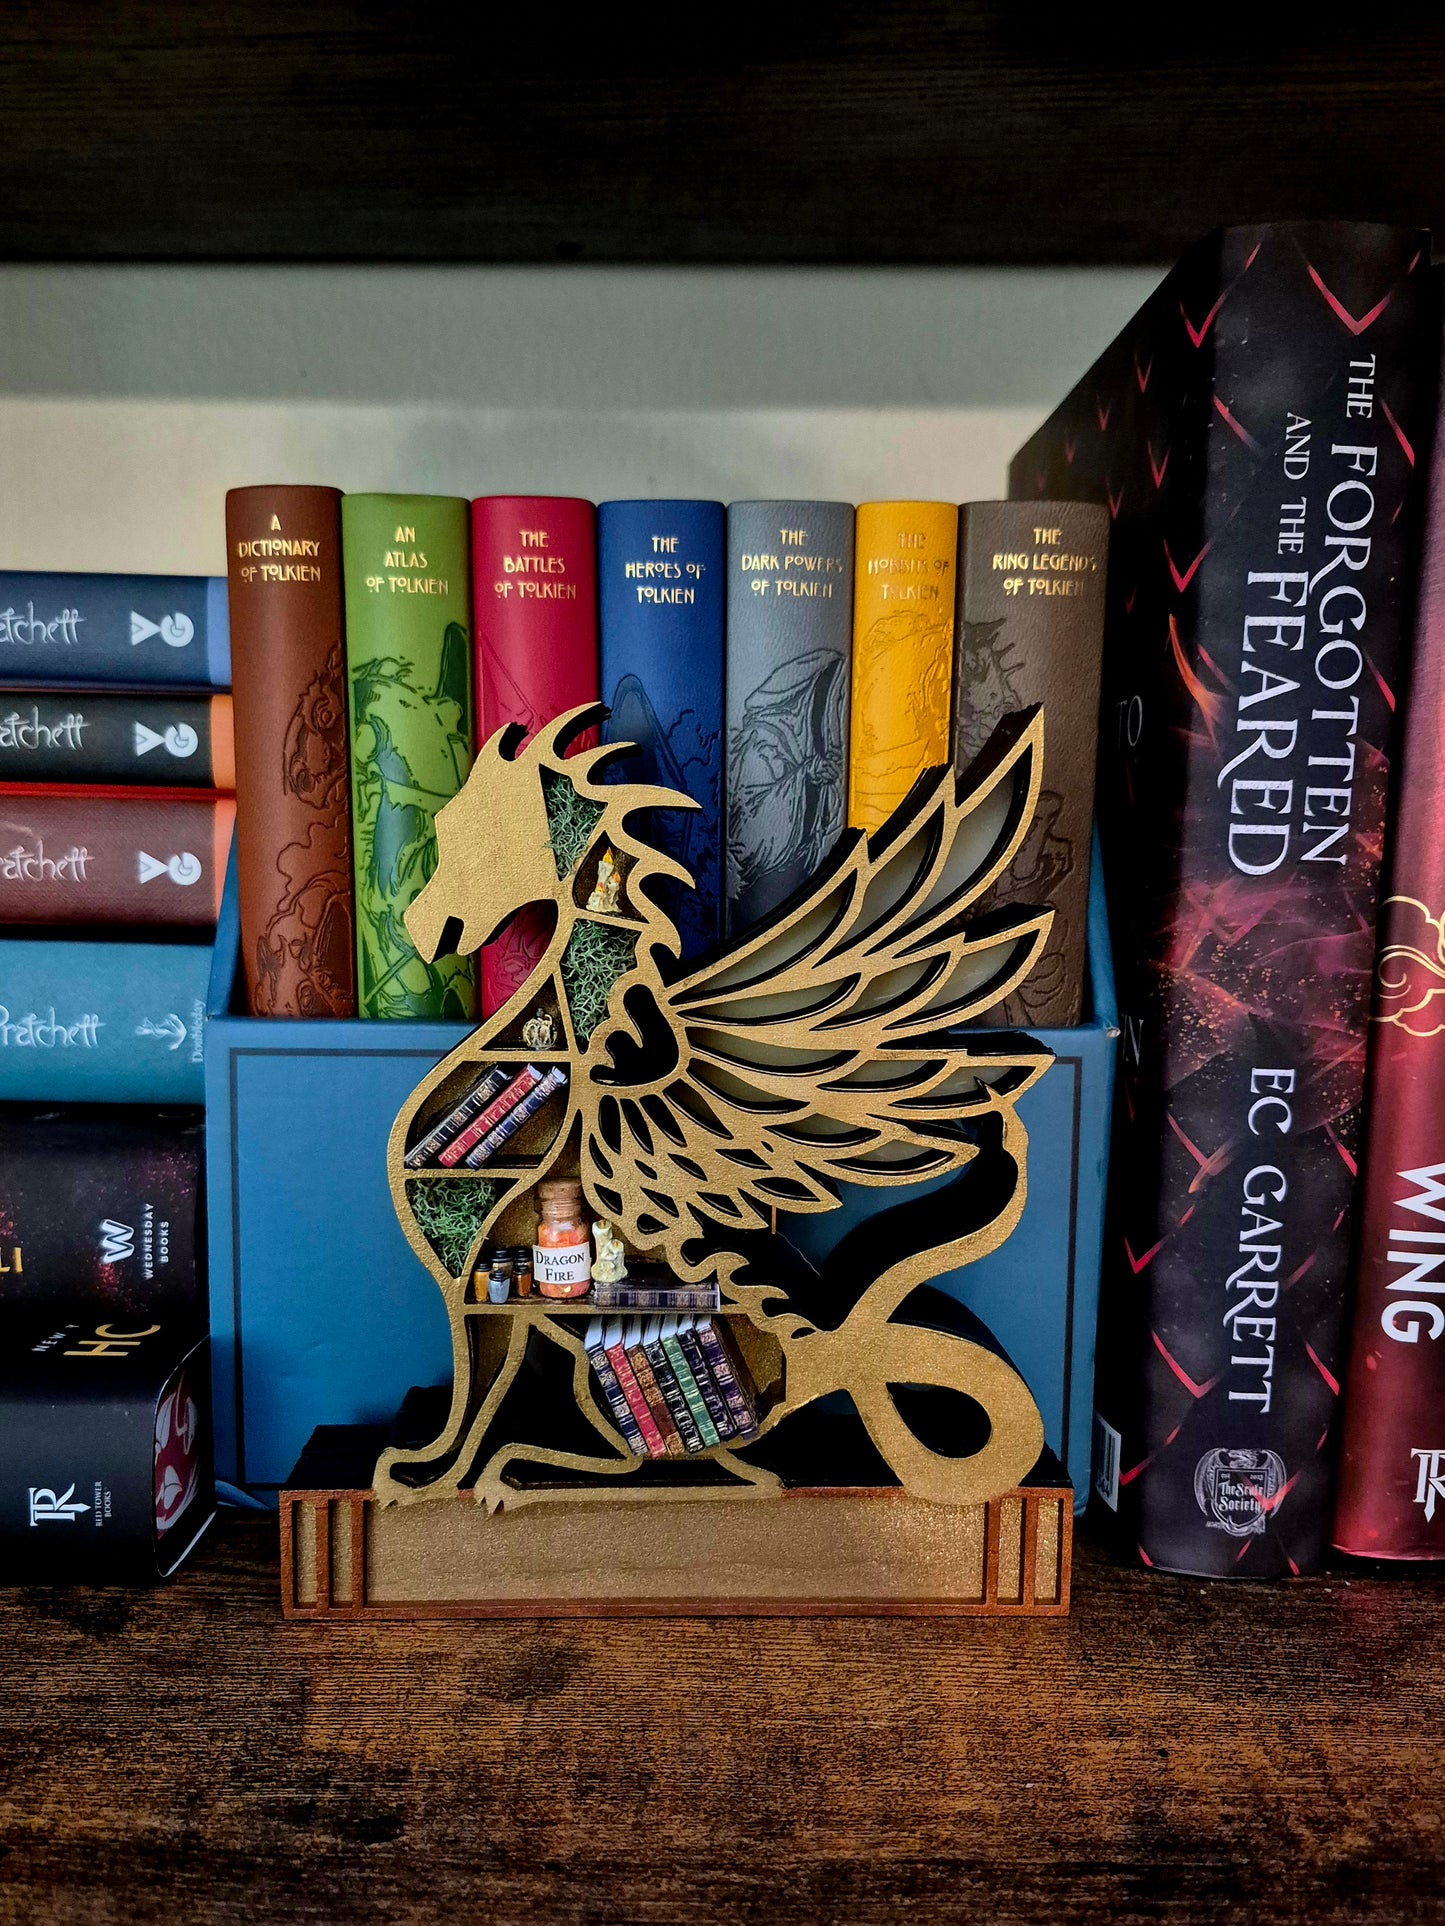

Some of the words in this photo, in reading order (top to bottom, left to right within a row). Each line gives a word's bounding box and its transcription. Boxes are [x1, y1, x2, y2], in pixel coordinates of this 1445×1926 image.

[1346, 354, 1376, 418] THE
[1284, 412, 1312, 480] AND
[270, 513, 282, 532] A
[1277, 496, 1307, 555] THE
[394, 525, 416, 544] AN
[519, 530, 550, 549] THE
[651, 535, 680, 554] THE
[780, 528, 809, 547] THE
[898, 532, 927, 550] THE
[1033, 527, 1063, 546] THE
[238, 538, 321, 559] DICTIONARY
[383, 551, 428, 569] ATLAS
[503, 556, 566, 574] BATTLES
[741, 554, 780, 573] DARK
[783, 555, 844, 574] POWERS
[933, 559, 950, 577] OF
[992, 552, 1029, 571] RING
[1032, 553, 1098, 572] LEGENDS
[241, 566, 257, 583] OF
[260, 564, 322, 582] TOLKIEN
[625, 561, 682, 580] HEROES
[685, 563, 707, 581] OF
[366, 576, 384, 594] OF
[387, 576, 450, 595] TOLKIEN
[494, 582, 513, 599] OF
[517, 582, 577, 600] TOLKIEN
[636, 586, 695, 605] TOLKIEN
[751, 579, 771, 597] OF
[775, 580, 833, 599] TOLKIEN
[881, 584, 939, 601] TOLKIEN
[1003, 577, 1024, 597] OF
[1028, 577, 1084, 597] TOLKIEN
[1300, 444, 1378, 866] FORGOTTEN
[1217, 571, 1309, 876] FEARED
[0, 839, 95, 883] atchett
[1247, 1067, 1296, 1136] EC
[144, 1203, 154, 1281] WEDNESDAY
[159, 1220, 170, 1265] BOOKS
[534, 1250, 586, 1267] DRAGON
[1380, 1162, 1445, 1344] WING
[545, 1266, 576, 1282] FIRE
[1225, 1164, 1288, 1414] GARRETT
[31, 1332, 67, 1352] NEW
[94, 1480, 103, 1510] TOWER
[104, 1490, 112, 1518] BOOKS
[1219, 1496, 1262, 1514] Society
[94, 1510, 103, 1528] RED
